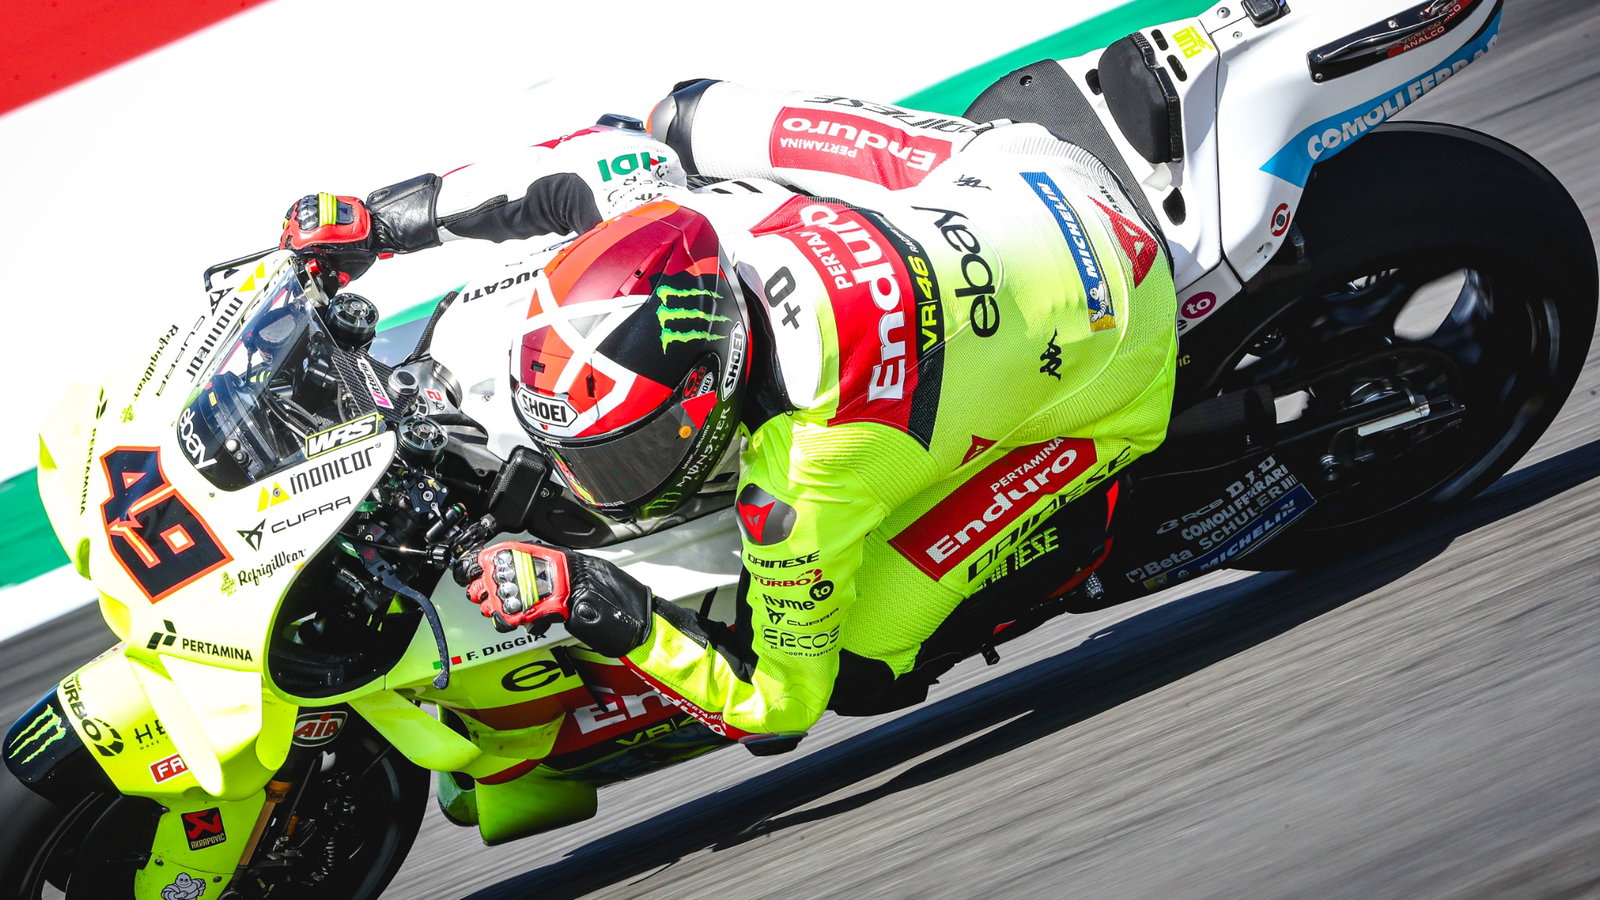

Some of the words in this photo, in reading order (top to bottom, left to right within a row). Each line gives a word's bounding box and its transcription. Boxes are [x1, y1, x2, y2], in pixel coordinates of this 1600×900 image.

[782, 117, 937, 171] Enduro
[1307, 91, 1405, 160] COMOLI
[780, 137, 858, 158] PERTAMINA
[1036, 182, 1099, 278] MICHELIN
[910, 205, 1000, 338] ebay
[724, 331, 744, 390] SHOEI
[521, 393, 567, 424] SHOEI
[307, 417, 376, 455] WRS
[990, 436, 1064, 493] PERTAMINA
[100, 446, 234, 605] 49
[270, 495, 352, 535] CUPRA
[925, 449, 1078, 564] Enduro
[1181, 503, 1237, 541] COMOLI
[237, 549, 305, 587] RefrigiWear
[747, 550, 821, 569] DAINESE
[1143, 549, 1194, 575] Beta
[182, 638, 253, 662] PERTAMINA
